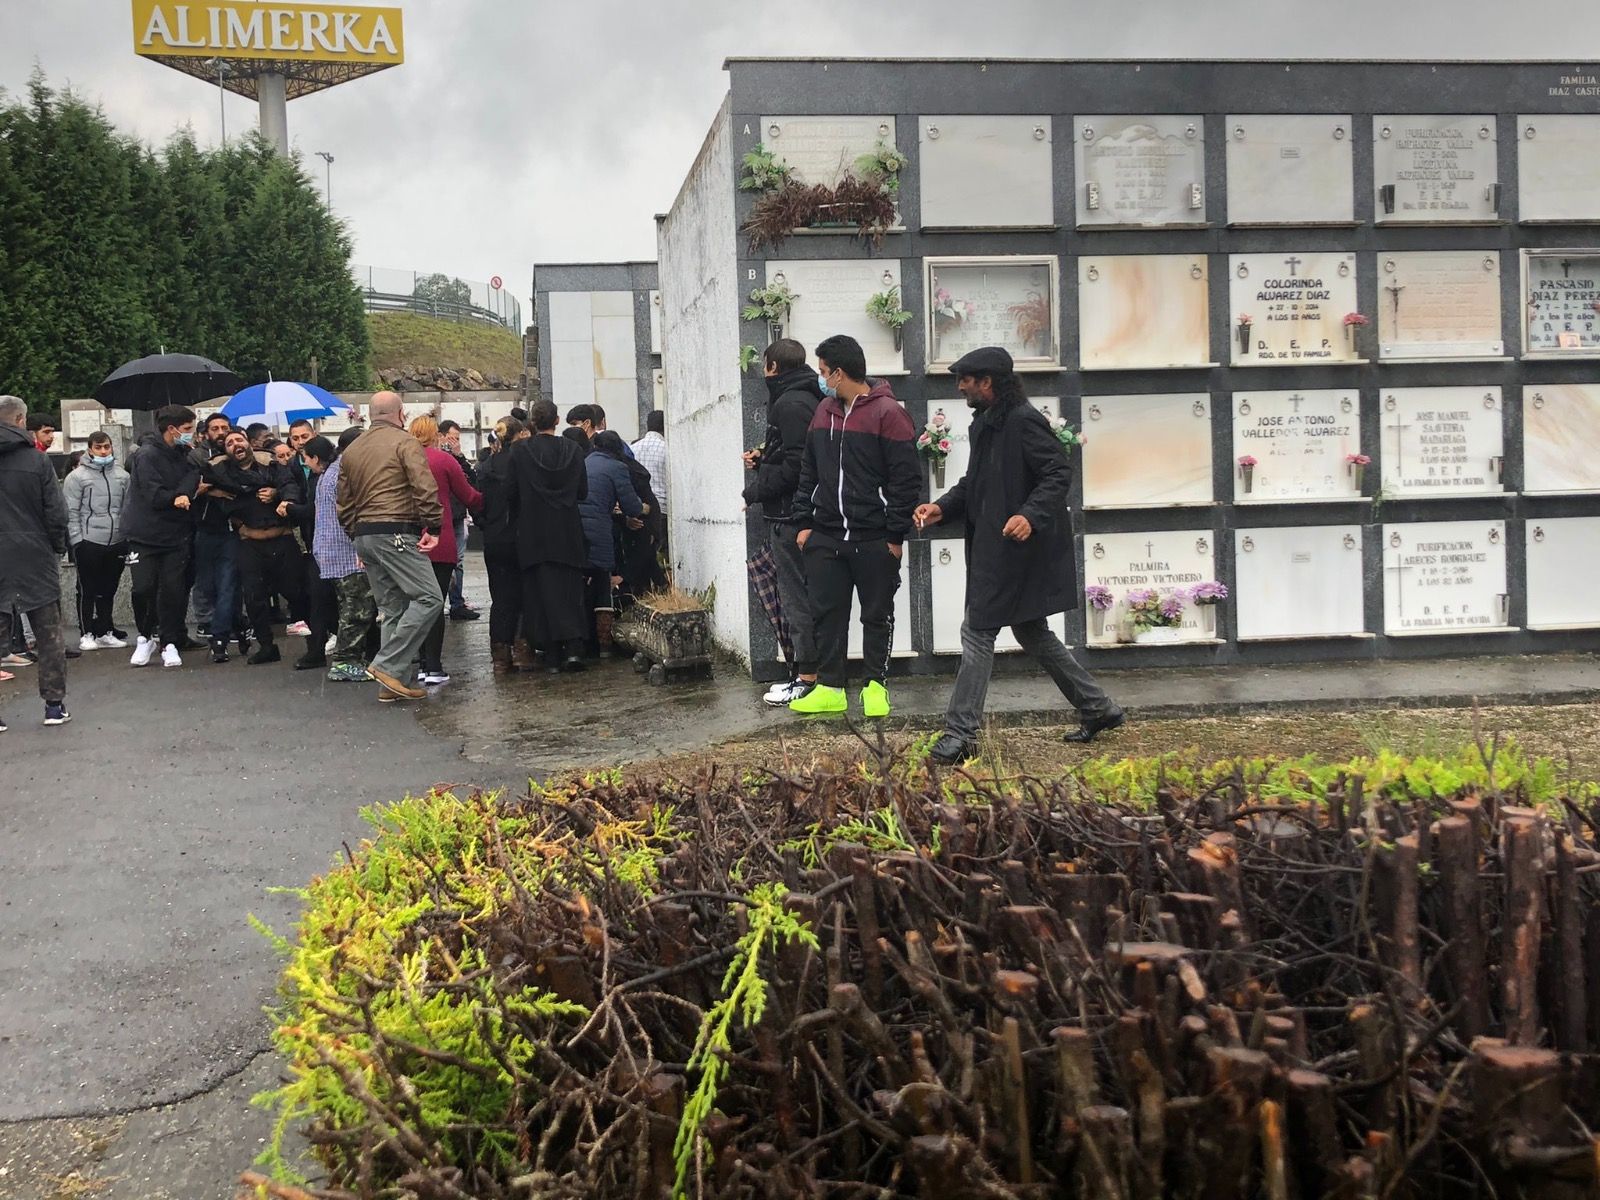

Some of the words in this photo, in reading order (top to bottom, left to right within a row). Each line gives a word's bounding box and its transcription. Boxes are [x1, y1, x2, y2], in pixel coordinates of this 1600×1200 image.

[141, 4, 398, 55] ALIMERKA
[1560, 76, 1597, 85] FAMILIA
[1549, 87, 1570, 96] DIAZ
[743, 123, 751, 135] A
[748, 269, 757, 280] B
[1264, 279, 1323, 289] COLORINDA
[1540, 279, 1594, 289] PASCASIO
[1257, 291, 1303, 301] ALVAREZ
[1306, 290, 1331, 300] DIAZ
[1532, 291, 1559, 301] DIAZ
[1258, 340, 1269, 350] D.
[1290, 339, 1300, 349] E.
[1321, 339, 1332, 348] P.
[1303, 350, 1332, 358] FAMILIA
[1257, 416, 1284, 426] JOSE
[1303, 426, 1350, 437] ALVAREZ
[1416, 541, 1473, 552] PURIFICACION
[1440, 552, 1487, 564] RODRIGUEZ
[1129, 562, 1170, 572] PALMIRA
[1097, 575, 1148, 586] VICTORERO
[1152, 573, 1202, 583] VICTORERO
